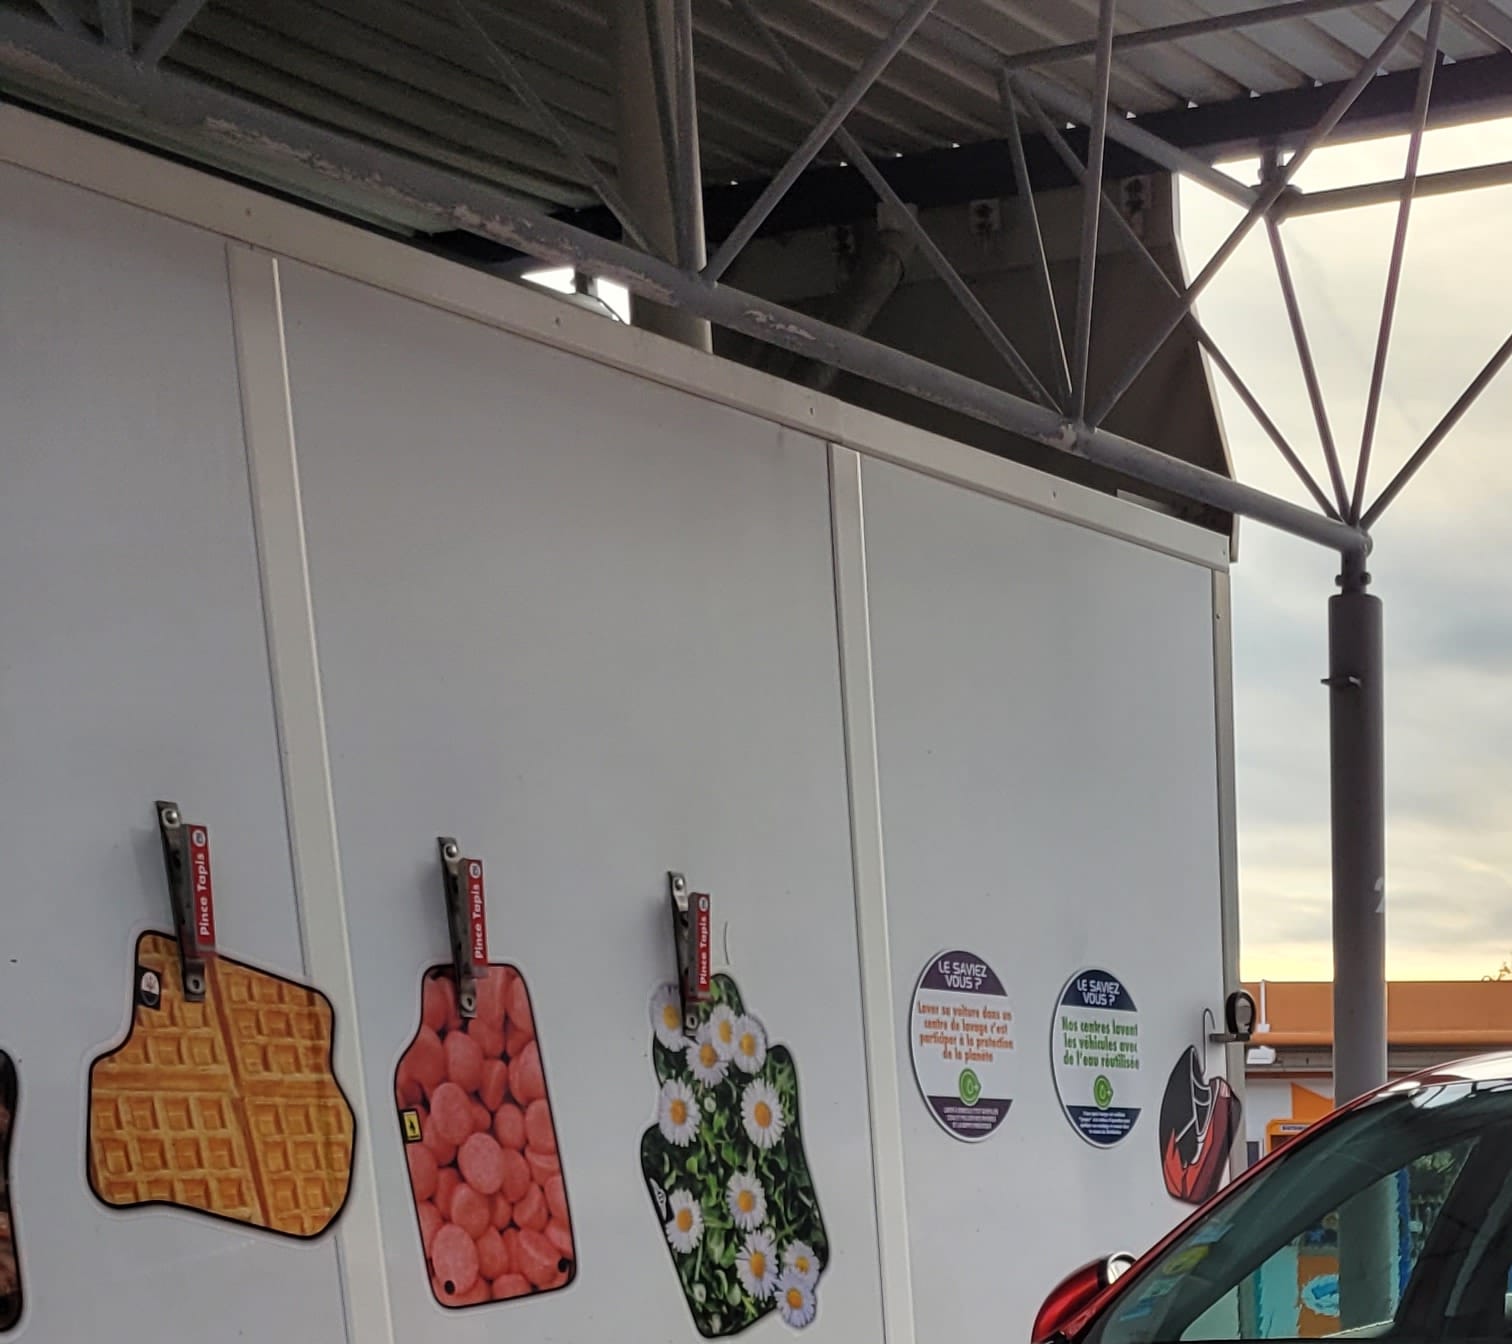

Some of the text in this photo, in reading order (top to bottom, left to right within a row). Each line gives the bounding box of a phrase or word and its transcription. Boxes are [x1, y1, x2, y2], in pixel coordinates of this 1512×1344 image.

[195, 852, 210, 936] Pince Tapis
[470, 883, 484, 959] Pince Tapis
[938, 960, 987, 978] LE SAVIEZ
[944, 975, 973, 989] VOUS
[1077, 979, 1120, 995] LE SAVIEZ
[1082, 992, 1107, 1006] VOUS
[1062, 1016, 1138, 1037] Nos centres lavent
[1064, 1032, 1076, 1048] les
[1078, 1034, 1117, 1051] véhicules
[1063, 1050, 1073, 1065] de
